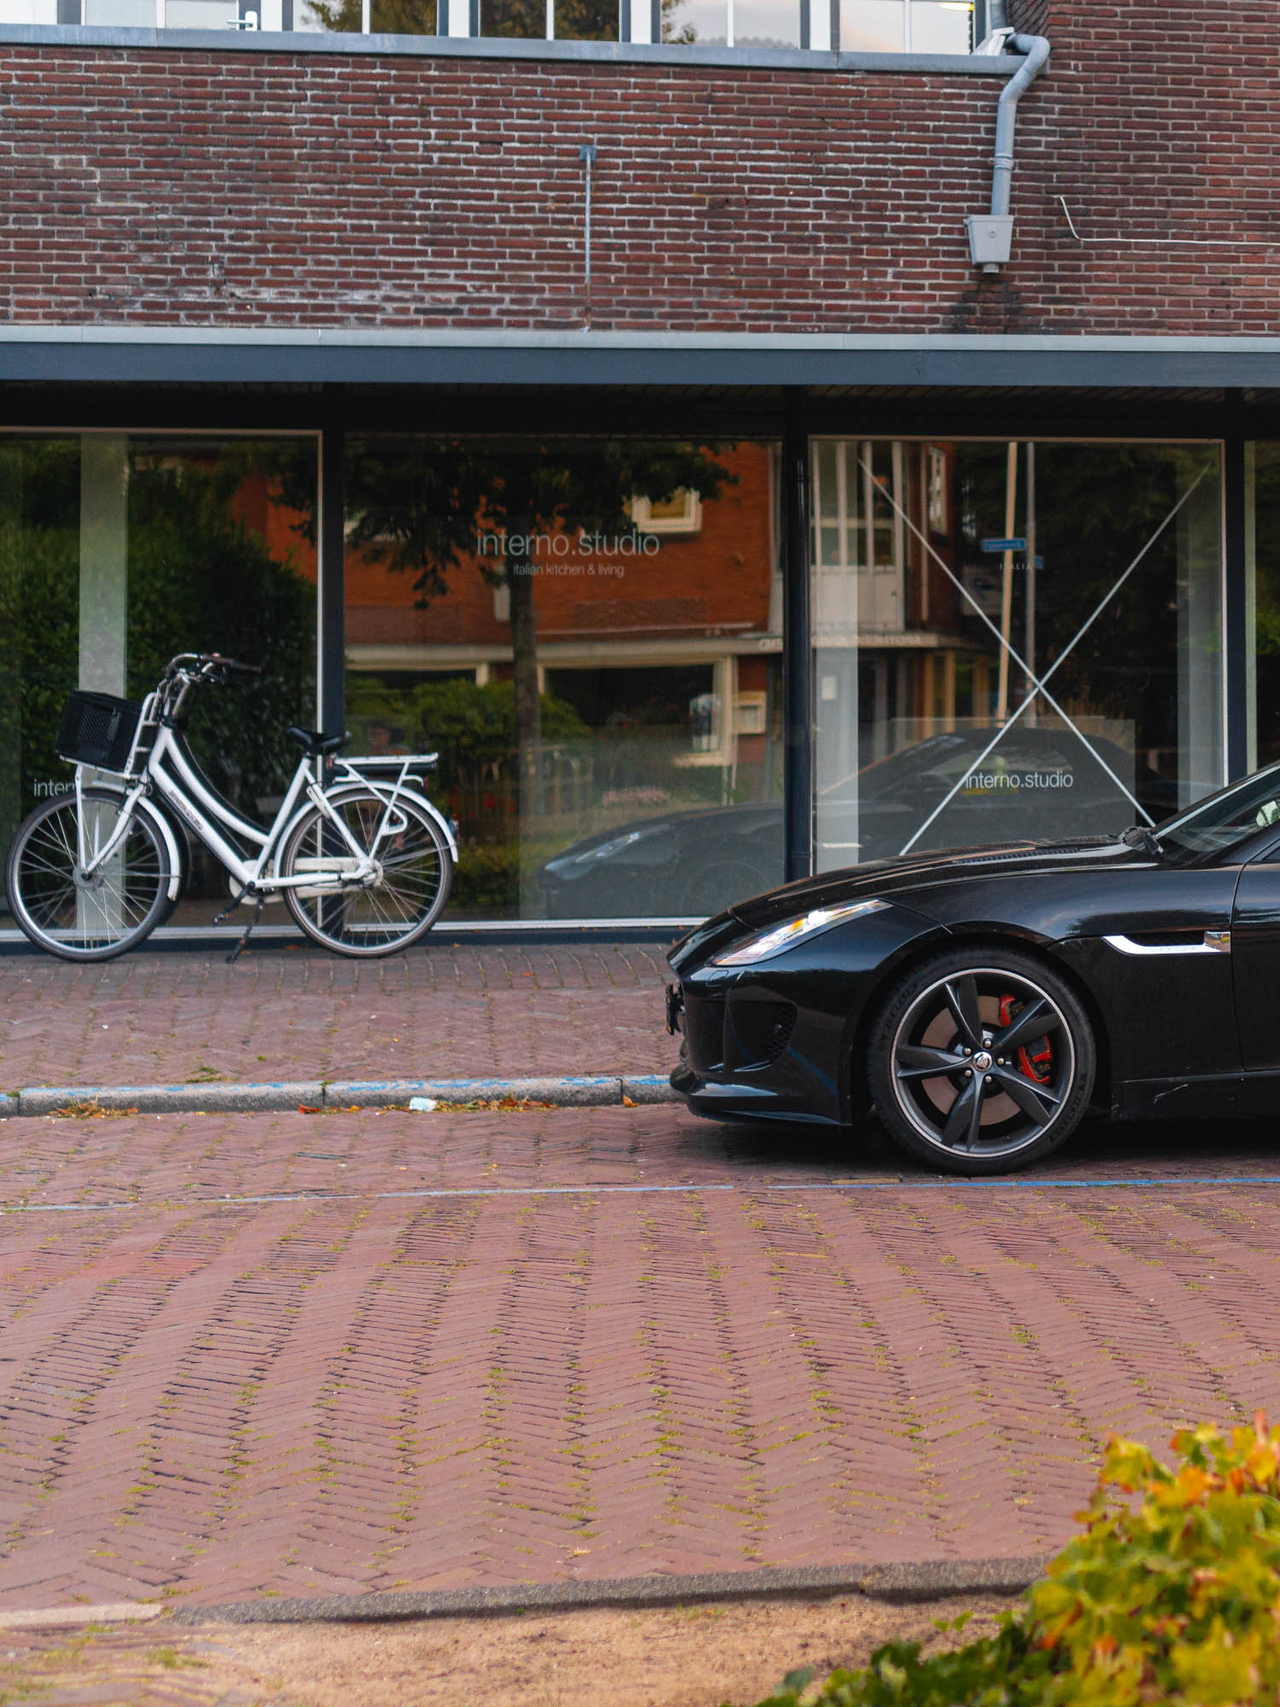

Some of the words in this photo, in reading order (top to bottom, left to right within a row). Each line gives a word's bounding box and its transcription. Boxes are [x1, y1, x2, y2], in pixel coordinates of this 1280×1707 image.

[477, 528, 661, 557] interno.studio
[513, 562, 544, 576] italian
[546, 562, 585, 576] kitchen
[588, 563, 595, 575] &
[598, 562, 625, 578] living
[966, 770, 1074, 789] interno.studio
